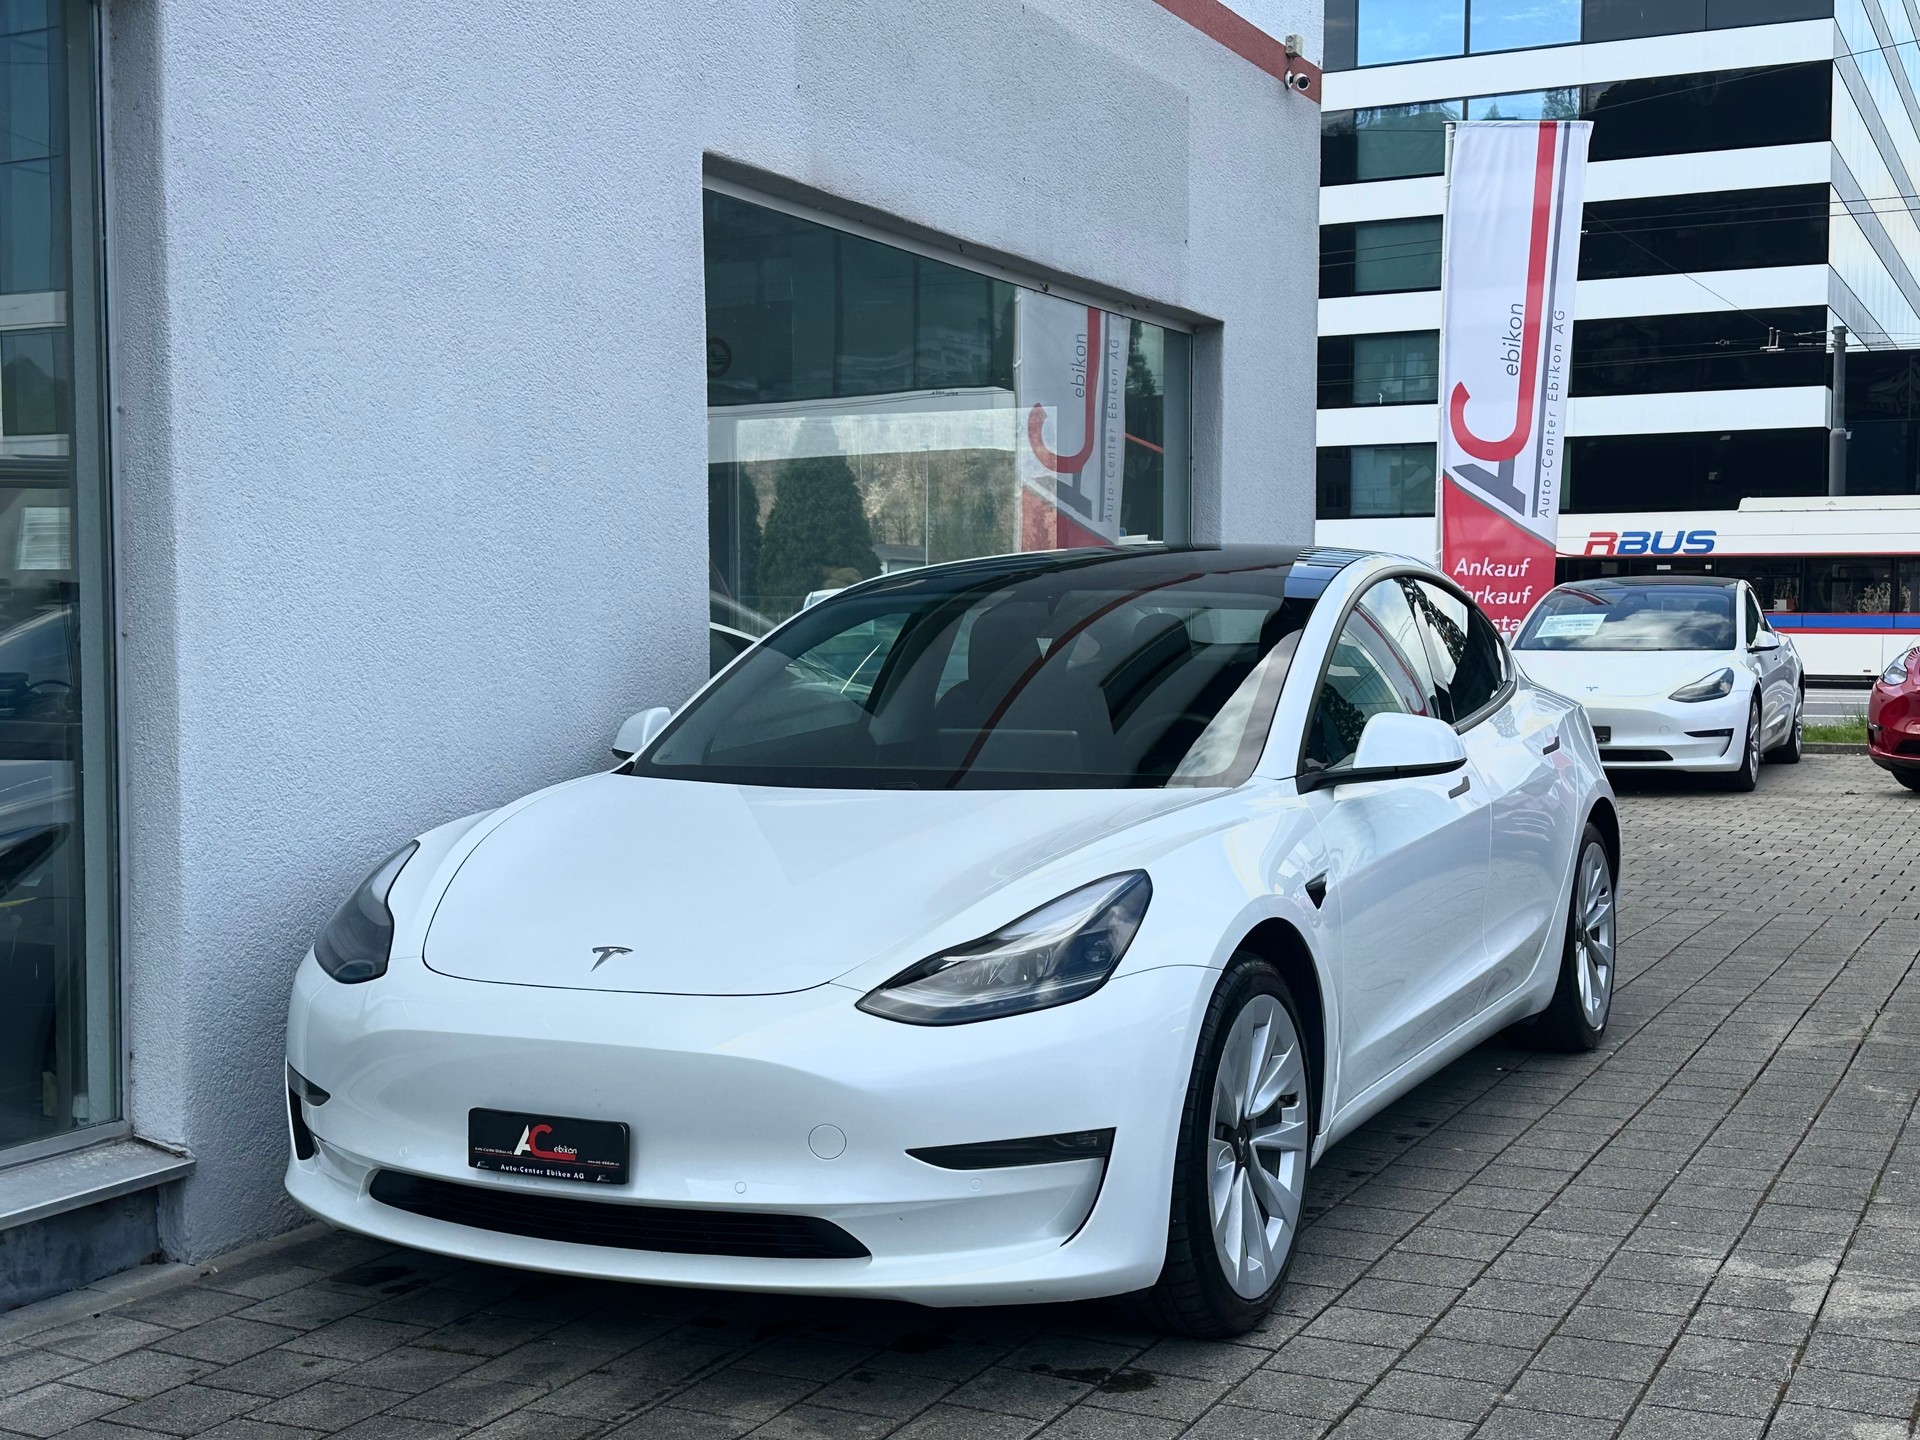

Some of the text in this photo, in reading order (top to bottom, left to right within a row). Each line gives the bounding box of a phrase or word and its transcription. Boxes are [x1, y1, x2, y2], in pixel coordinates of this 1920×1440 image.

[1500, 303, 1524, 376] ebikon
[1070, 333, 1087, 398] ebikon
[1105, 339, 1120, 523] Auto-Center Ebikon AG
[1539, 310, 1565, 518] Auto-Center Ebikon AG
[1584, 530, 1717, 556] RBUS
[1453, 557, 1531, 577] Ankauf
[513, 1124, 576, 1160] AC
[553, 1145, 578, 1154] ebikon
[500, 1164, 543, 1175] Auto-Center
[546, 1168, 571, 1178] Ebikon
[573, 1172, 585, 1180] AG
